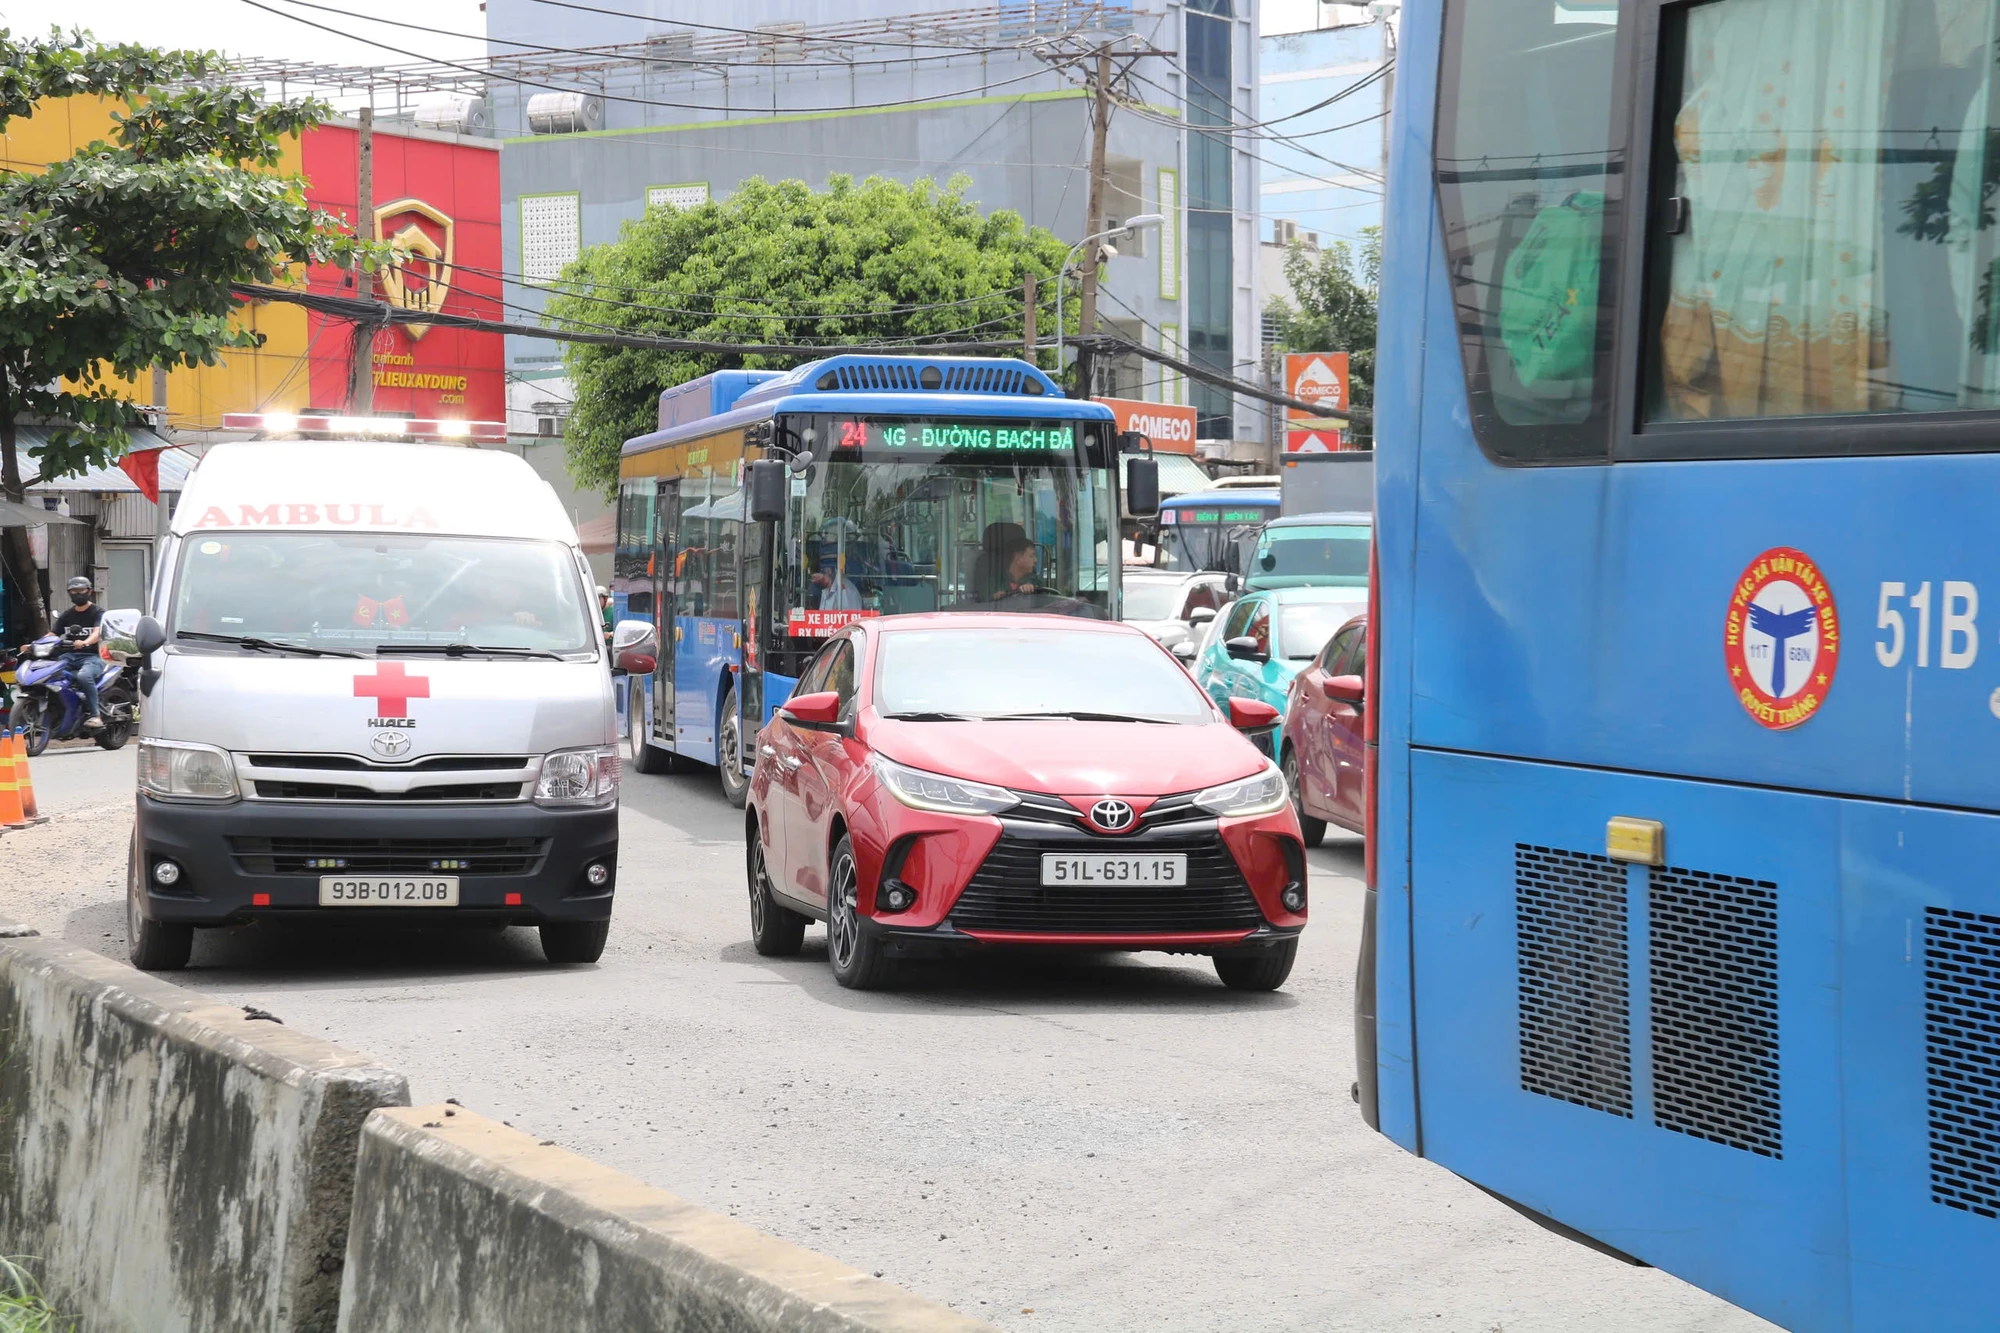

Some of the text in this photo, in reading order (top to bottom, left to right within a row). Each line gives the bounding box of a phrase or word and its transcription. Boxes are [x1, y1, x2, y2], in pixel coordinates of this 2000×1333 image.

[372, 371, 467, 391] TLIEUXAYDUNG
[1299, 386, 1341, 396] COMECO
[841, 422, 867, 446] 24
[922, 424, 991, 448] ĐƯỜNG
[1129, 413, 1191, 441] COMECO
[1810, 581, 1828, 605] XE
[808, 613, 821, 625] XE
[824, 611, 848, 626] BUÝT
[1875, 581, 1979, 669] 51B
[368, 718, 416, 728] HIACE
[1055, 861, 1175, 880] 51L-631.15
[333, 882, 447, 899] 93B-012.08
